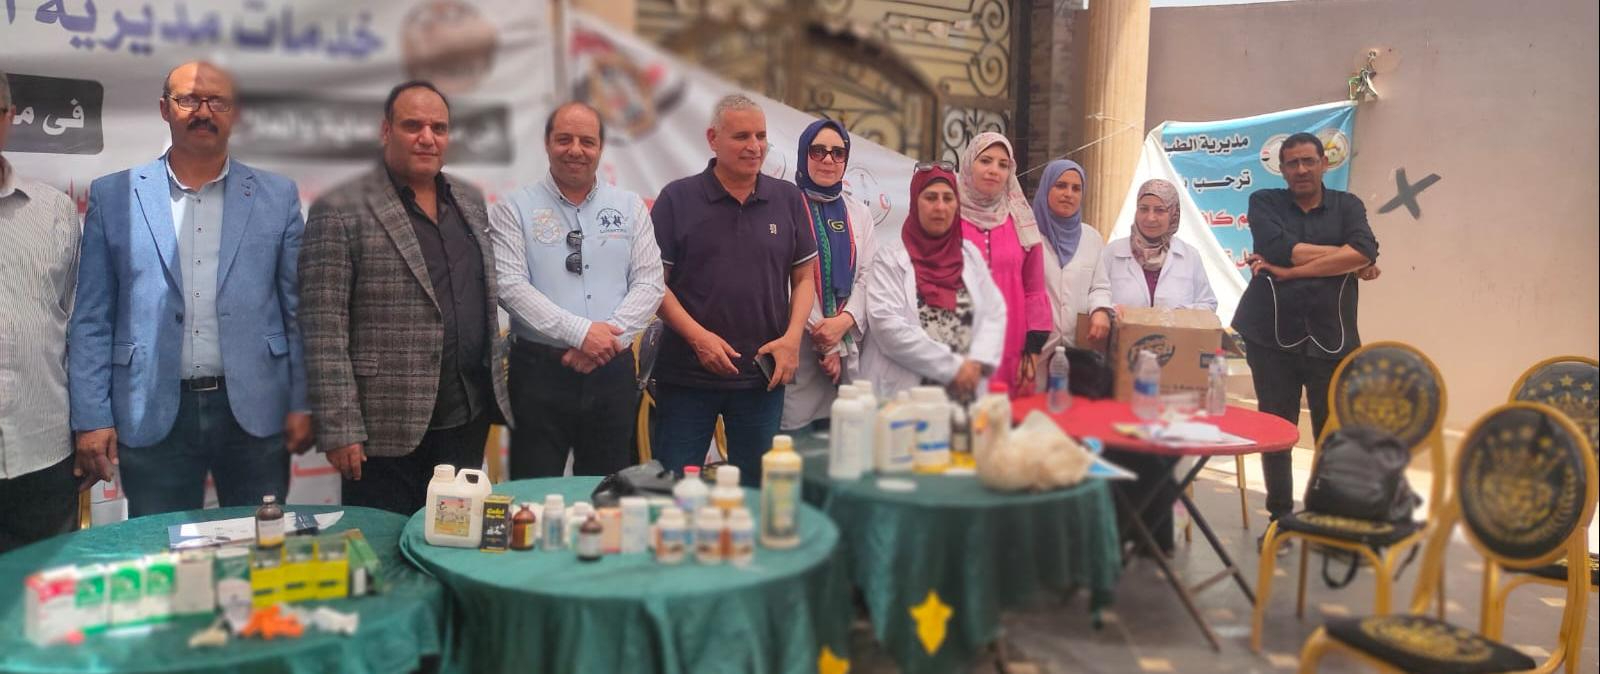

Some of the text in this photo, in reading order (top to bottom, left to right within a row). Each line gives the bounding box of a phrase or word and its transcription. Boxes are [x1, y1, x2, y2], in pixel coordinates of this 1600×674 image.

[233, 0, 383, 57] خدمات
[1201, 135, 1249, 154] مديرية
[1194, 171, 1251, 192] ترحب
